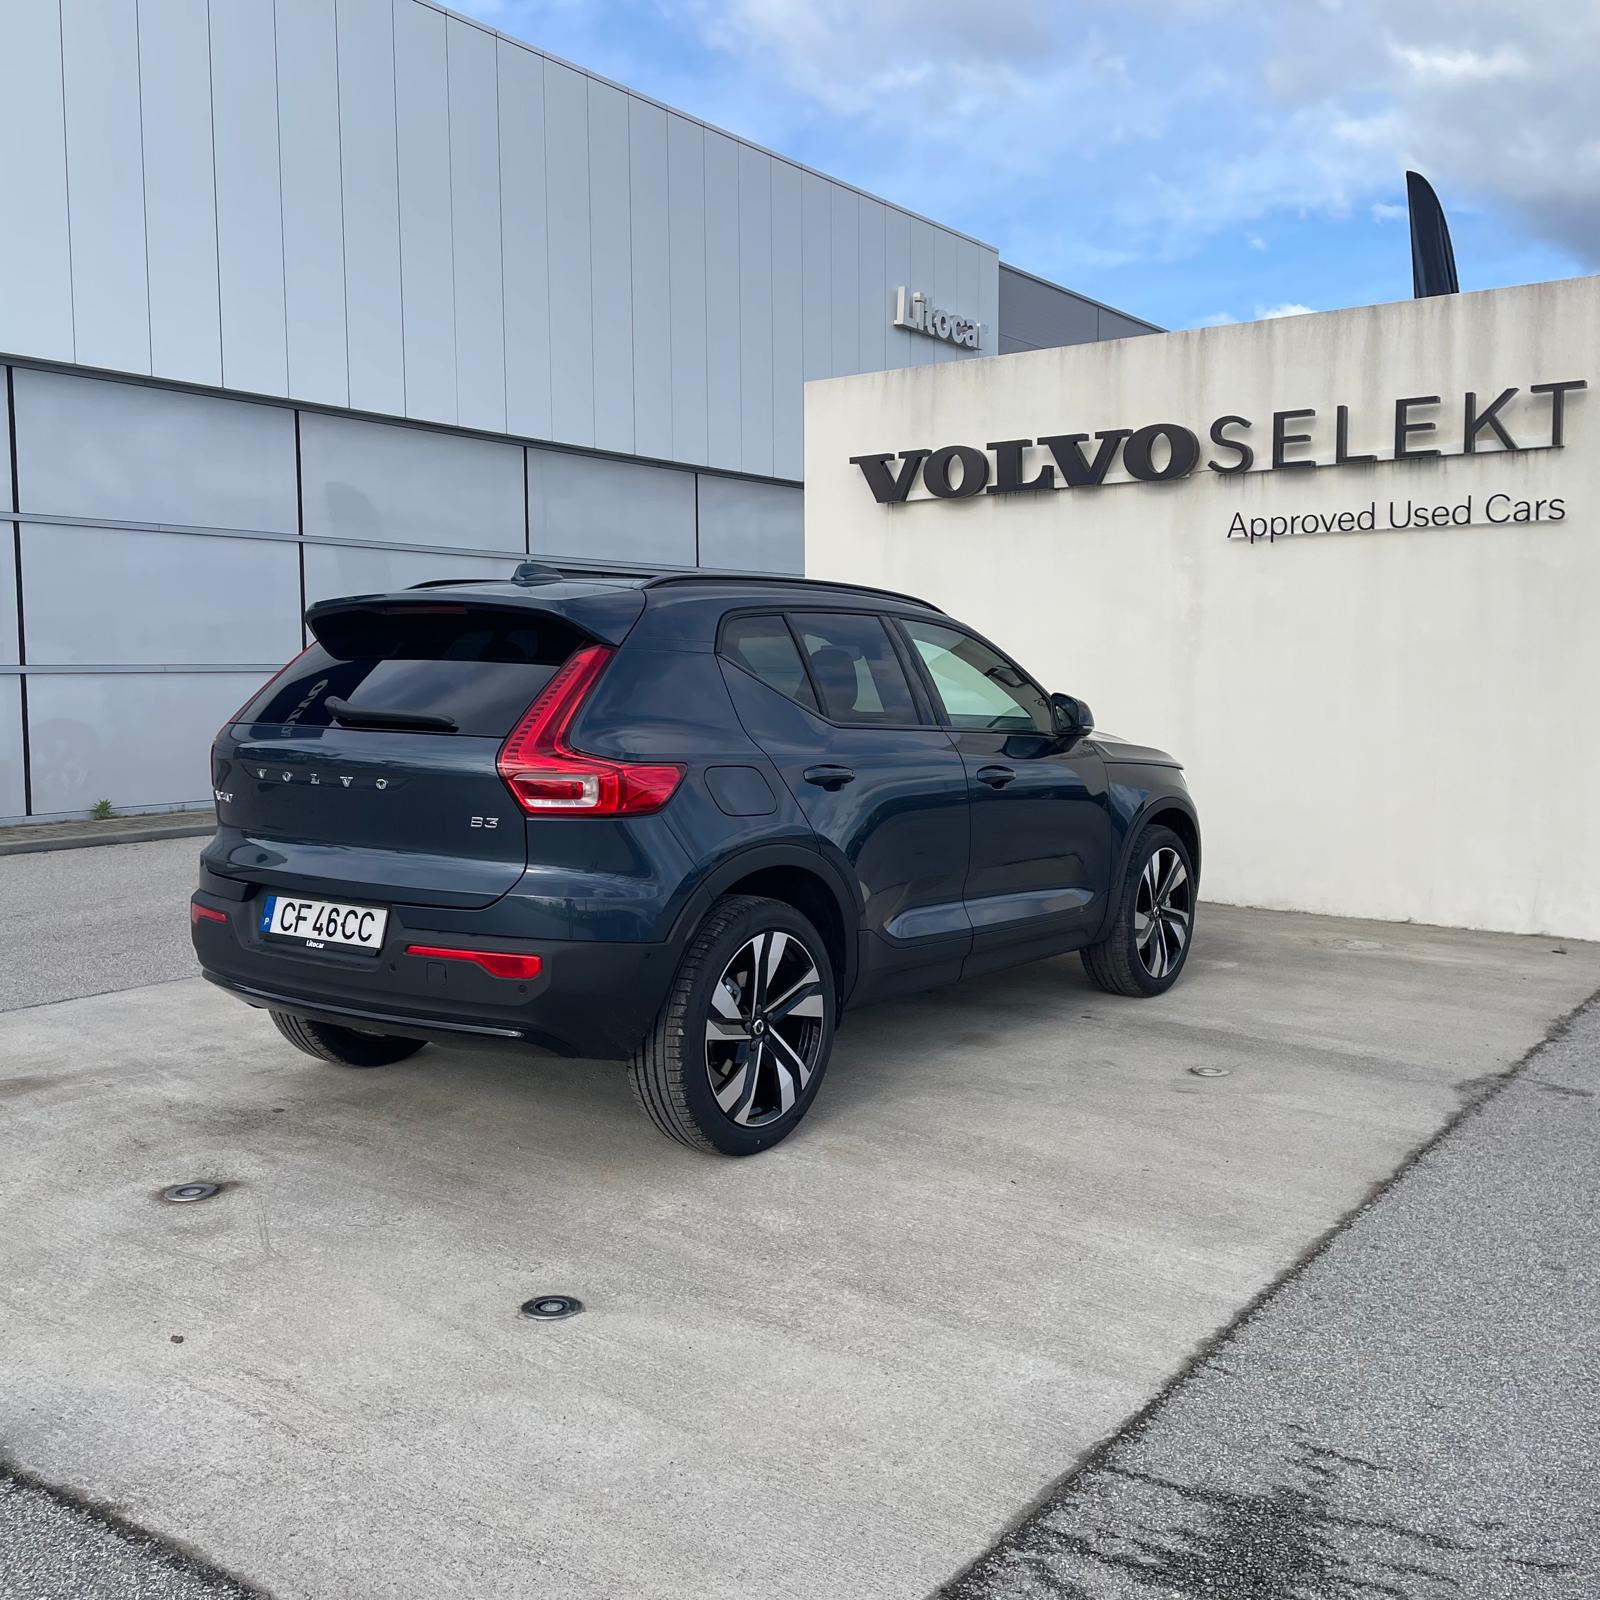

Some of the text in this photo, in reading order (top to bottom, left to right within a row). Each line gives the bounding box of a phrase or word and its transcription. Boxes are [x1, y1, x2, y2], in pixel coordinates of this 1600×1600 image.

[893, 286, 989, 349] Litoca
[849, 379, 1588, 504] VOLVO SELEKT
[1226, 493, 1566, 544] Approved Used Cars
[256, 767, 388, 790] VOLVO
[470, 816, 499, 829] B3
[263, 917, 270, 926] P
